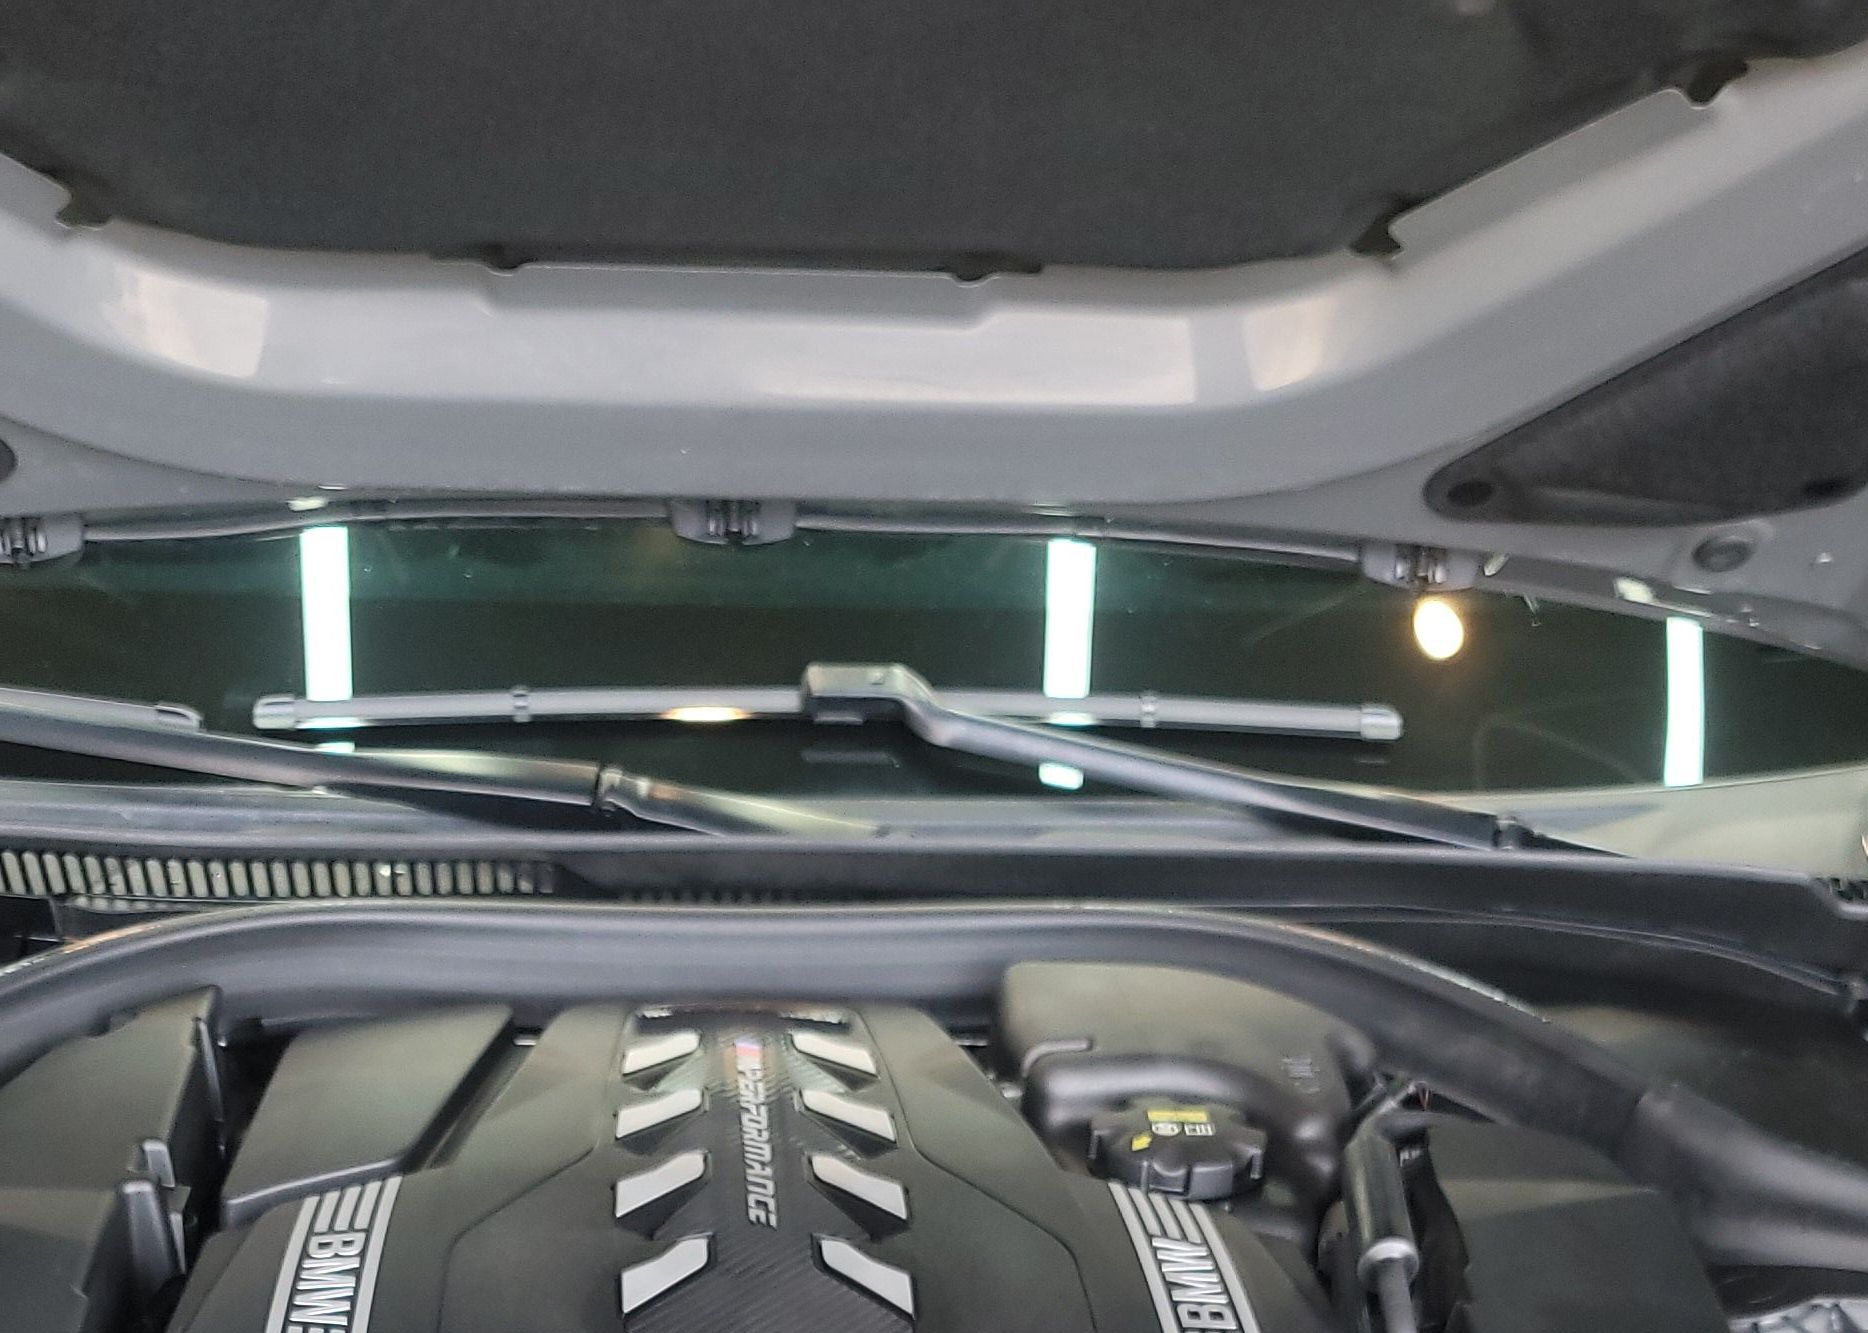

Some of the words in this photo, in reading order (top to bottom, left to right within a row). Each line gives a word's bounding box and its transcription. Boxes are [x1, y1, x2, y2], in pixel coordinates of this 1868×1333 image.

[738, 1067, 778, 1231] PERFORMANCE
[289, 1232, 367, 1326] BMW
[1151, 1236, 1238, 1331] BMW
